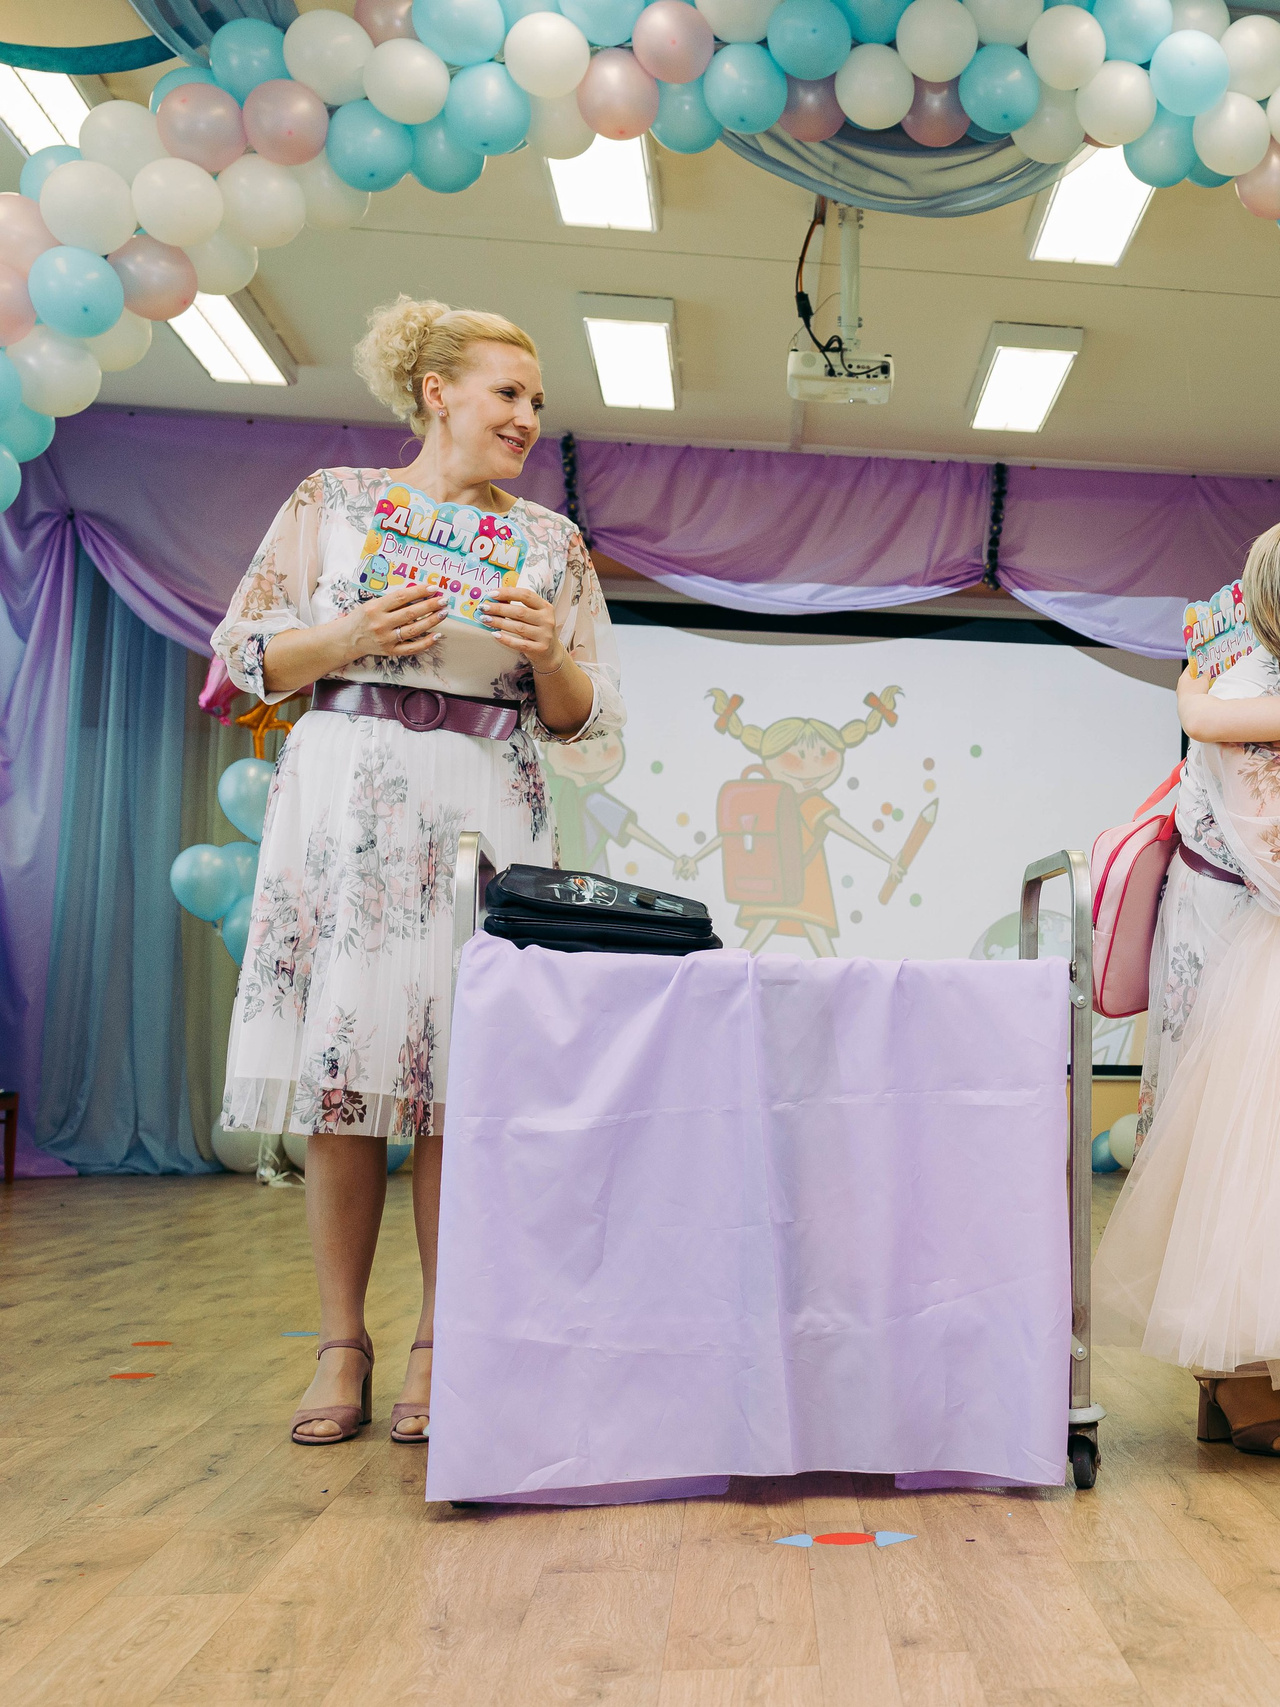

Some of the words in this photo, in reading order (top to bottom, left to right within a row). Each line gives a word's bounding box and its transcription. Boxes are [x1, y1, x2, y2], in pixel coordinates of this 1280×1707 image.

[381, 505, 520, 571] ДИПЛОМ
[393, 562, 482, 600] ДЕТСКОГО
[1191, 602, 1250, 651] ДИПЛО
